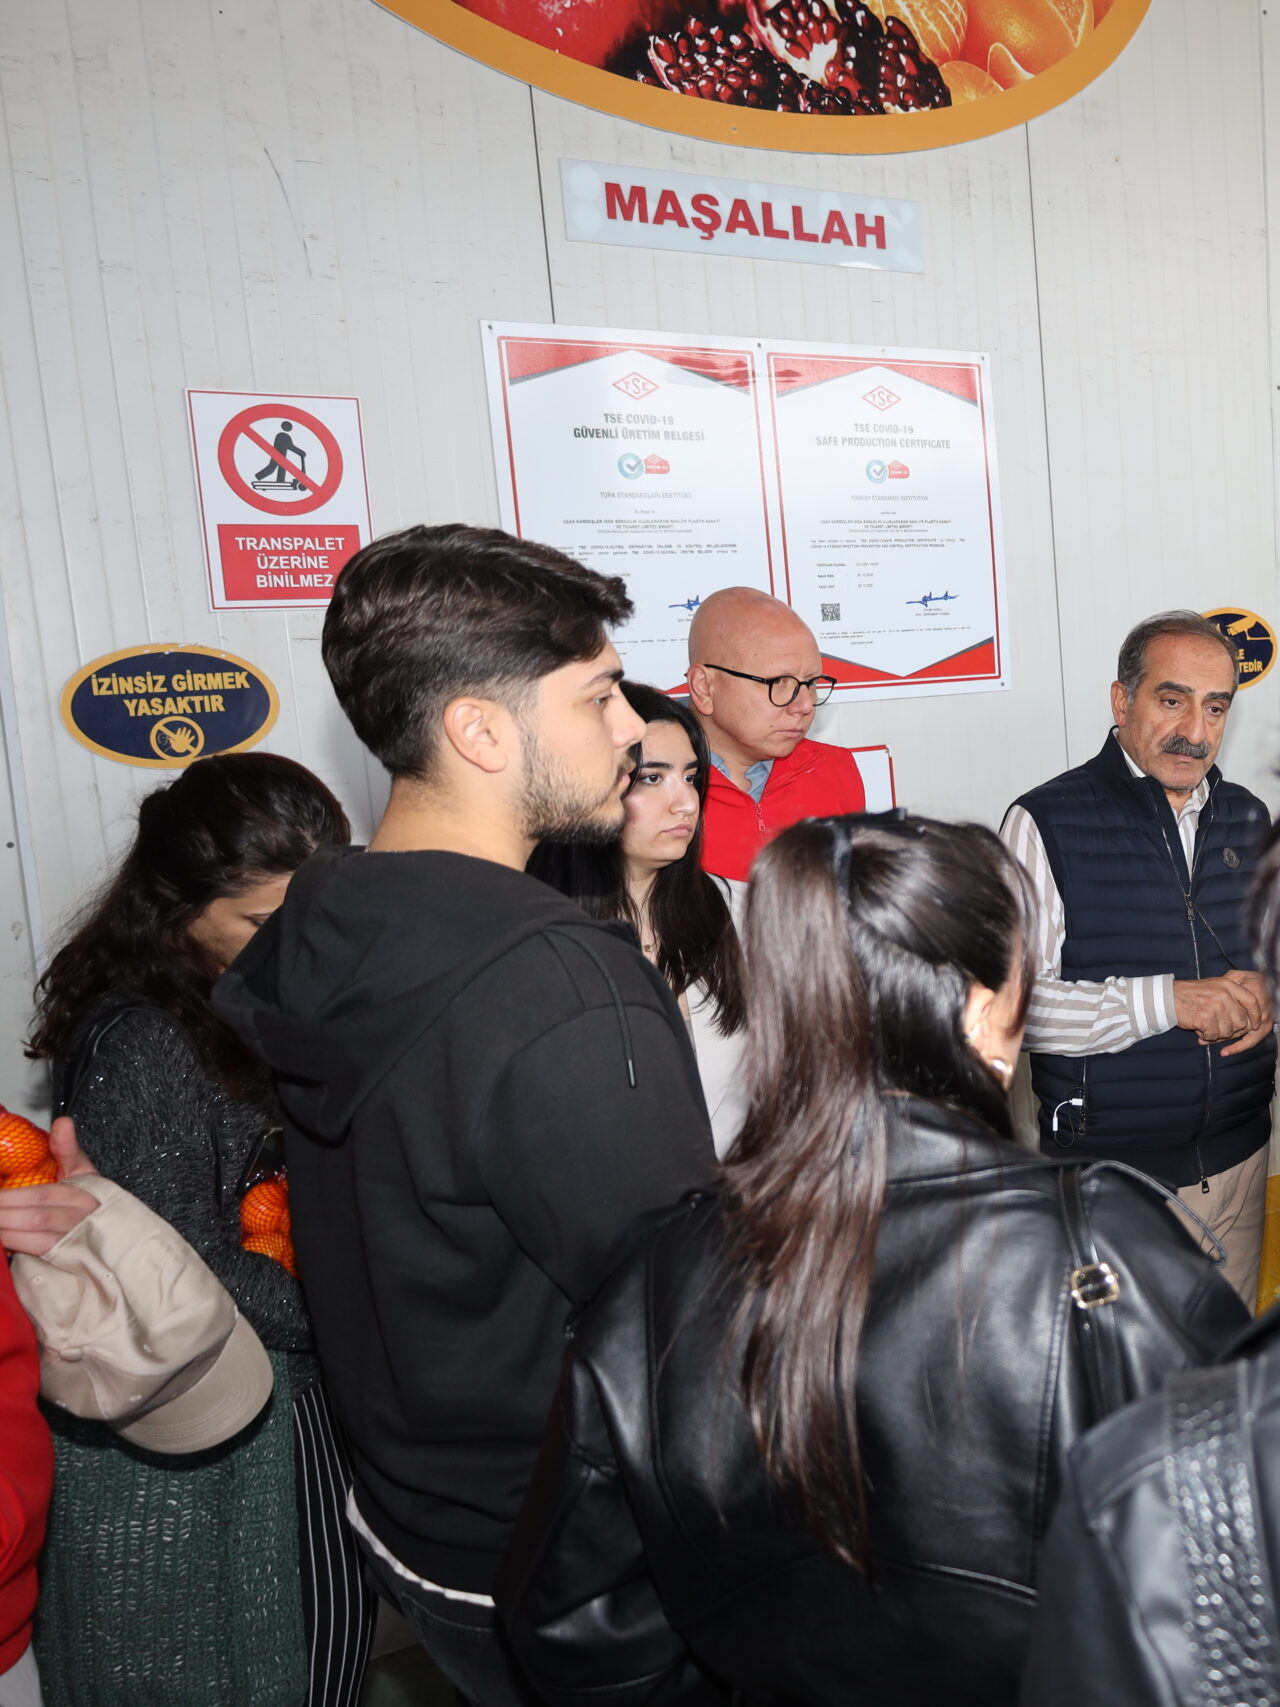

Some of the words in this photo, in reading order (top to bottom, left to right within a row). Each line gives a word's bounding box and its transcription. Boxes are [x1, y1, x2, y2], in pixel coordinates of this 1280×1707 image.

[604, 181, 887, 250] MAŞALLAH
[603, 413, 623, 424] TSE
[626, 414, 675, 426] COVID-19
[573, 425, 619, 440] GÜVENLİ
[622, 427, 661, 441] ÜRETİM
[664, 429, 705, 442] BELGESİ
[853, 422, 871, 433] TSE
[873, 423, 914, 435] COVID-19
[816, 436, 839, 447] SAFE
[841, 437, 897, 448] PRODUCTION
[899, 438, 951, 450] CERTIFICATE
[235, 536, 345, 551] TRANSPALET
[256, 552, 330, 570] ÜZERİNE
[255, 571, 335, 589] BİNİLMEZ
[90, 671, 168, 697] İZİNSİZ
[171, 669, 251, 692] GİRMEK
[123, 694, 226, 718] YASAKTIR
